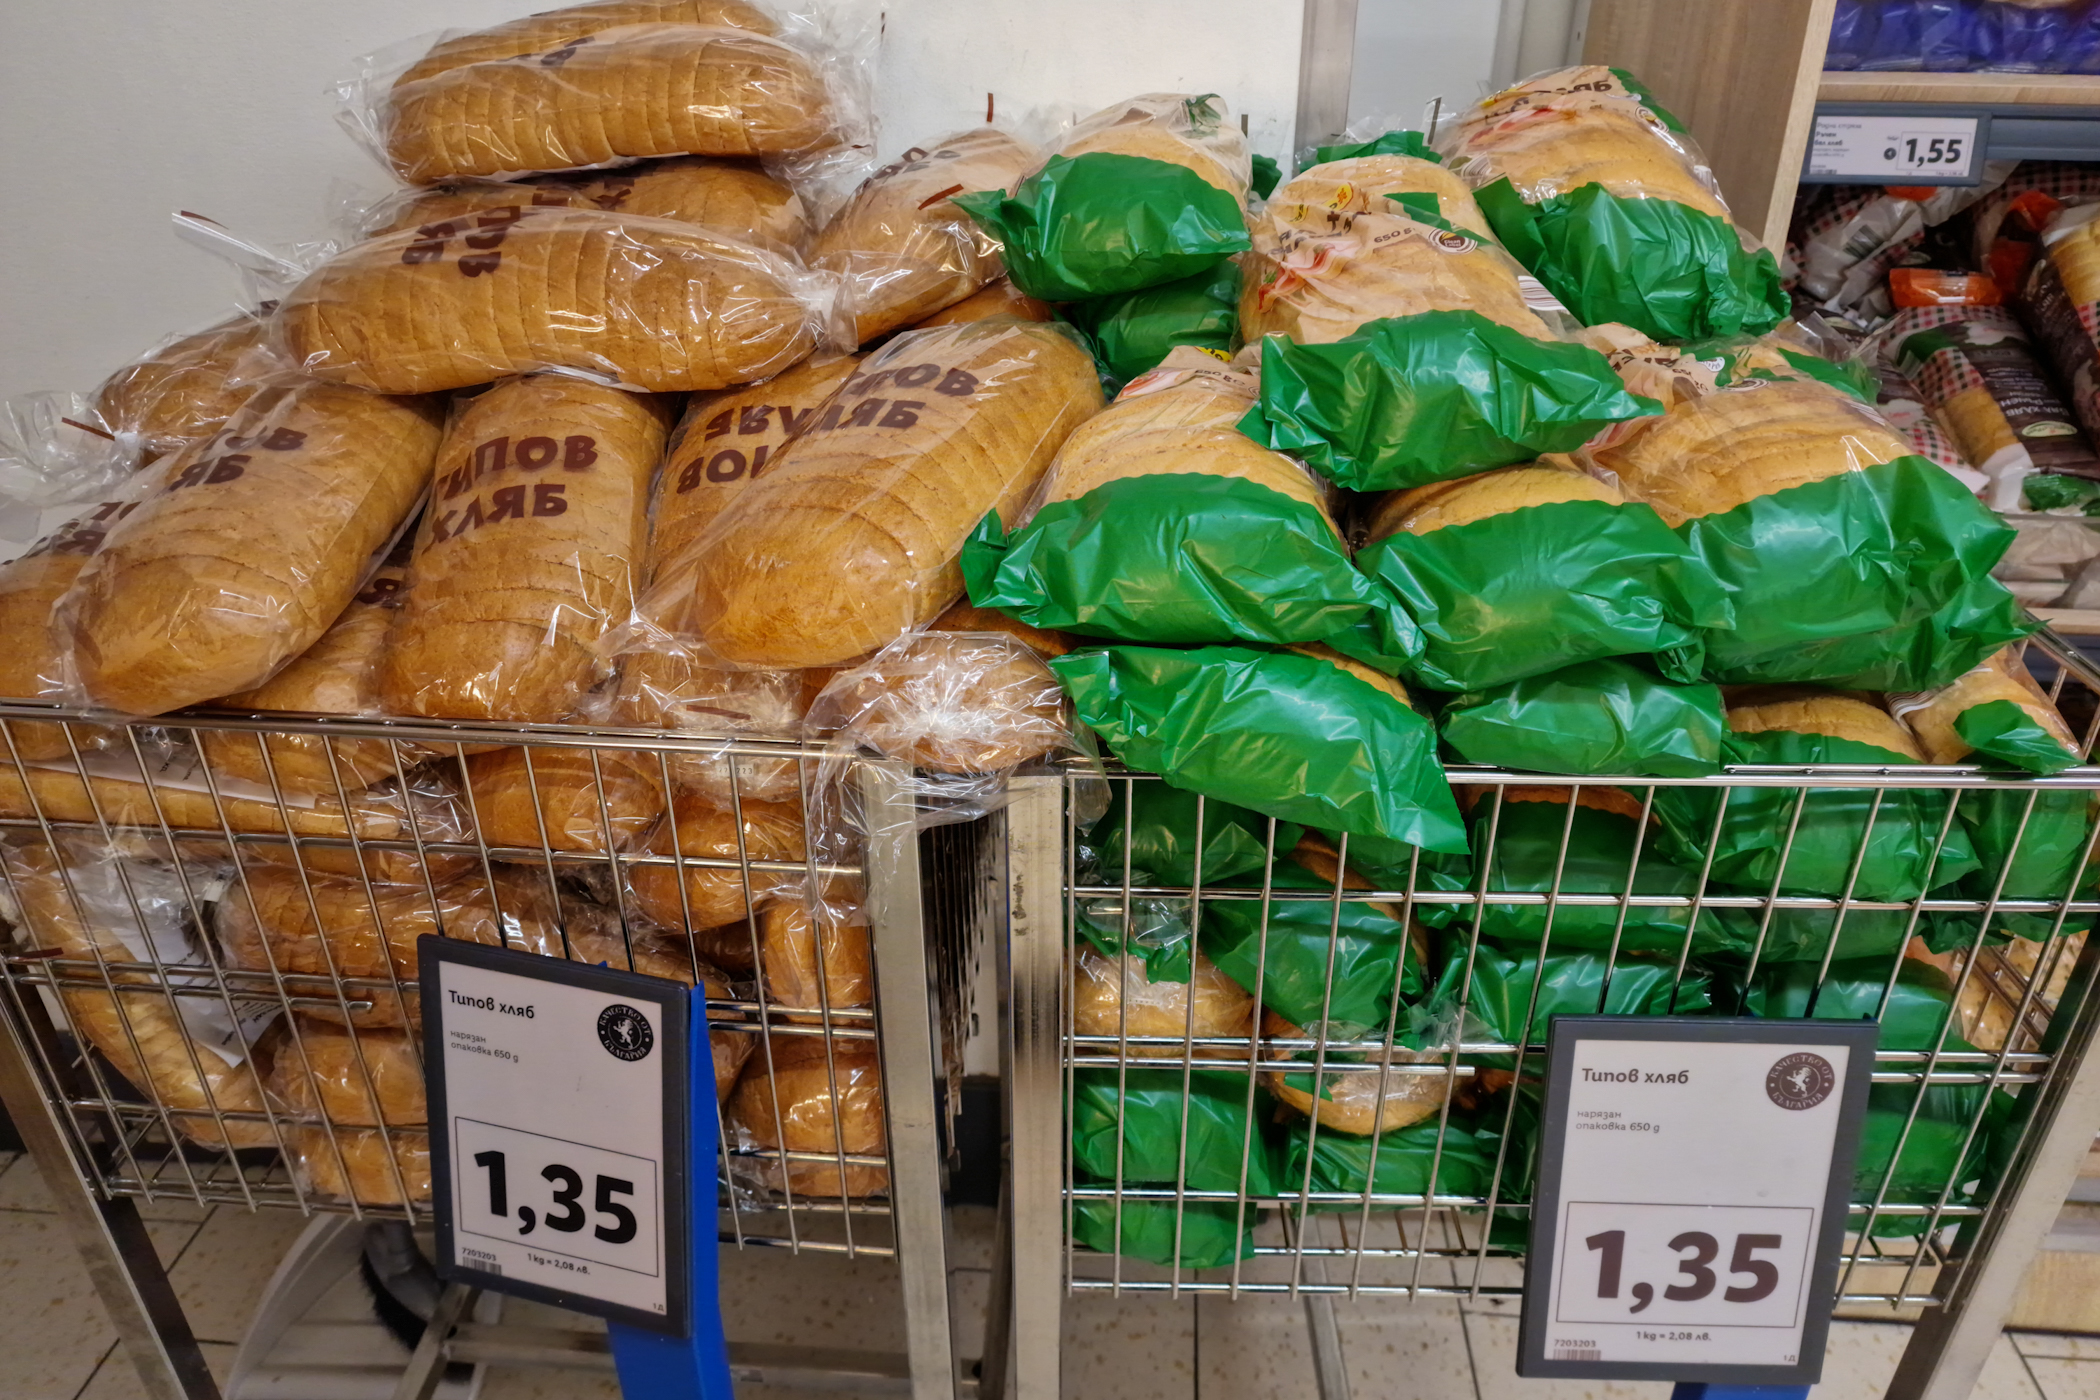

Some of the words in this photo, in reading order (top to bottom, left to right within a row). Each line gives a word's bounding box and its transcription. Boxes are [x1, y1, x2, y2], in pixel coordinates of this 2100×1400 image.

[1906, 138, 1963, 168] 1,55
[1374, 230, 1401, 243] 650
[448, 989, 495, 1011] Типов
[499, 1003, 535, 1019] хляб
[450, 1030, 486, 1043] нарязан
[451, 1042, 492, 1056] опаковка
[494, 1049, 511, 1060] 650
[513, 1055, 519, 1063] g
[1582, 1068, 1639, 1083] Типов
[1644, 1070, 1689, 1084] хляб
[1577, 1111, 1622, 1120] нарязан
[1575, 1122, 1626, 1131] опаковка
[1629, 1122, 1651, 1131] 650
[1653, 1125, 1660, 1133] g
[473, 1150, 637, 1244] 1,35
[462, 1247, 497, 1262] 7203203
[554, 1259, 574, 1271] 2,08
[1585, 1230, 1783, 1314] 1,35
[1554, 1339, 1597, 1348] 7203203
[1668, 1332, 1692, 1341] 2,08
